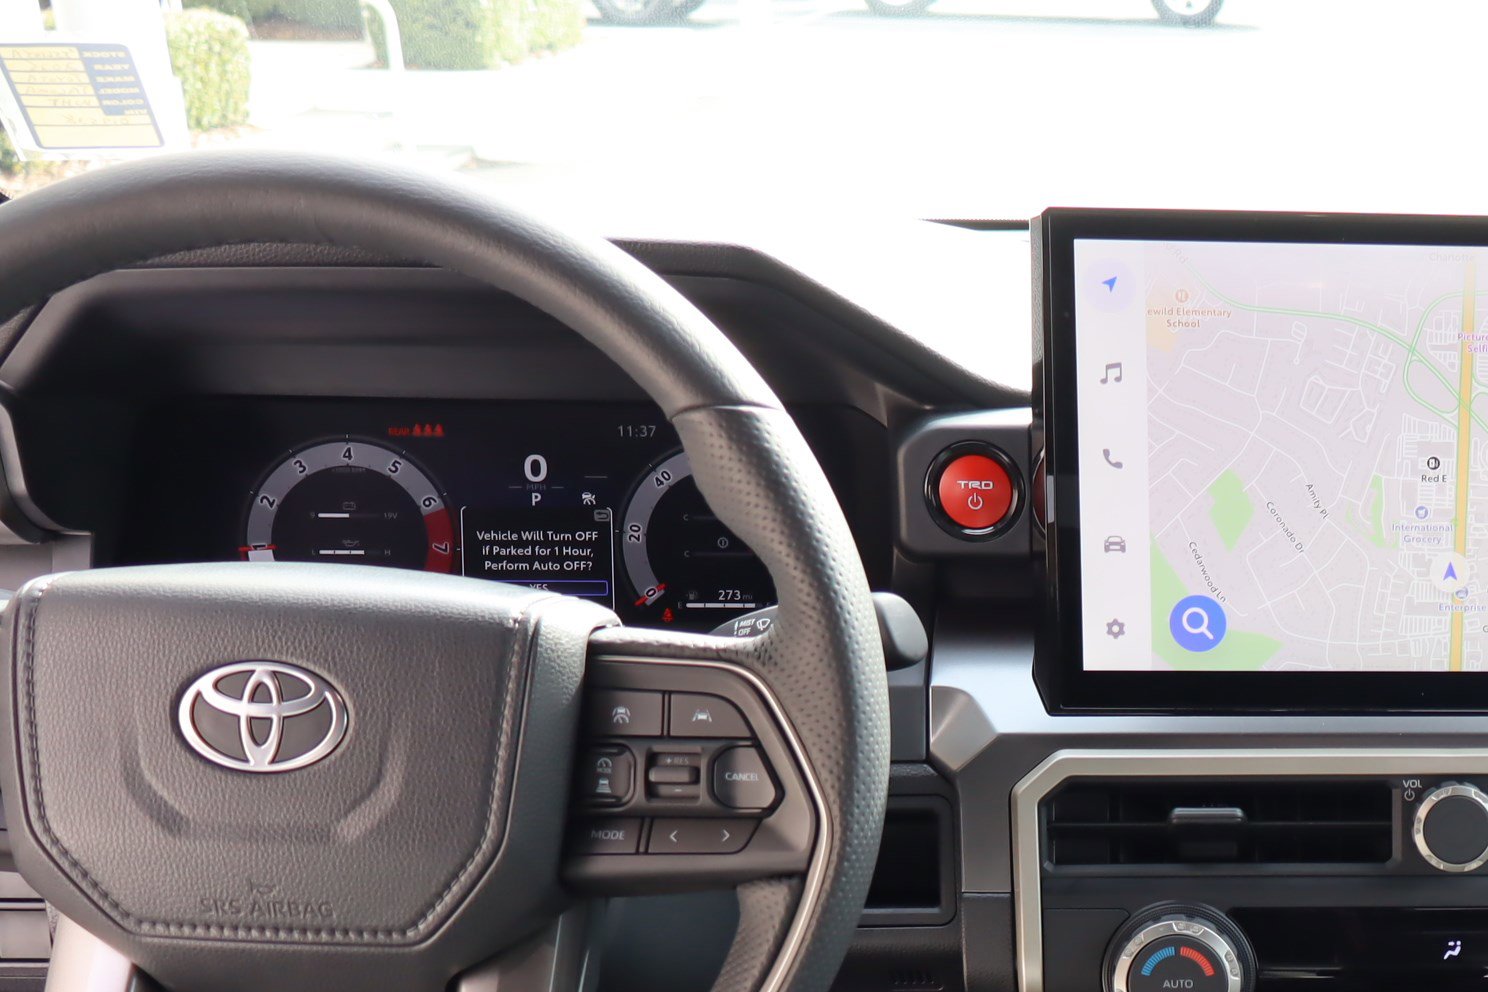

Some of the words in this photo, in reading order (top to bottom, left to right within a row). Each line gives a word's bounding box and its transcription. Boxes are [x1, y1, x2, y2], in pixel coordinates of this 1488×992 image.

[1175, 308, 1232, 319] Elementary
[1166, 318, 1201, 328] School
[617, 425, 656, 437] 11:37
[342, 446, 353, 461] 4
[293, 459, 307, 474] 3
[387, 459, 402, 474] 5
[653, 470, 672, 488] 40
[1421, 474, 1438, 483] Red
[1442, 474, 1447, 483] E
[956, 480, 994, 490] TRD
[259, 494, 276, 509] 2
[422, 496, 437, 508] 6
[531, 493, 542, 507] P
[1305, 483, 1324, 512] Amity
[1266, 500, 1296, 544] Coronado
[1293, 540, 1304, 553] Dr
[1391, 523, 1453, 533] International
[476, 530, 518, 541] Vehicle
[520, 530, 544, 541] Will
[546, 531, 572, 541] Turn
[575, 531, 598, 541] OFF
[627, 524, 642, 543] 20
[1403, 534, 1442, 545] Grocery
[432, 542, 449, 554] 7
[482, 545, 491, 556] if
[493, 546, 532, 556] Parked
[534, 546, 550, 556] for
[554, 547, 559, 556] 1
[563, 546, 594, 558] Hour,
[484, 560, 530, 571] Perform
[532, 560, 560, 571] Auto
[563, 560, 593, 571] OFF?
[1188, 541, 1220, 594] Cedarwood
[1216, 590, 1227, 603] Ln
[718, 589, 741, 601] 273
[1438, 604, 1487, 613] Enterprise
[725, 771, 759, 781] CANCEL
[1402, 779, 1422, 788] VOL
[591, 830, 625, 840] MODE
[250, 899, 334, 918] AIRBAG
[1163, 979, 1194, 989] AUTO
